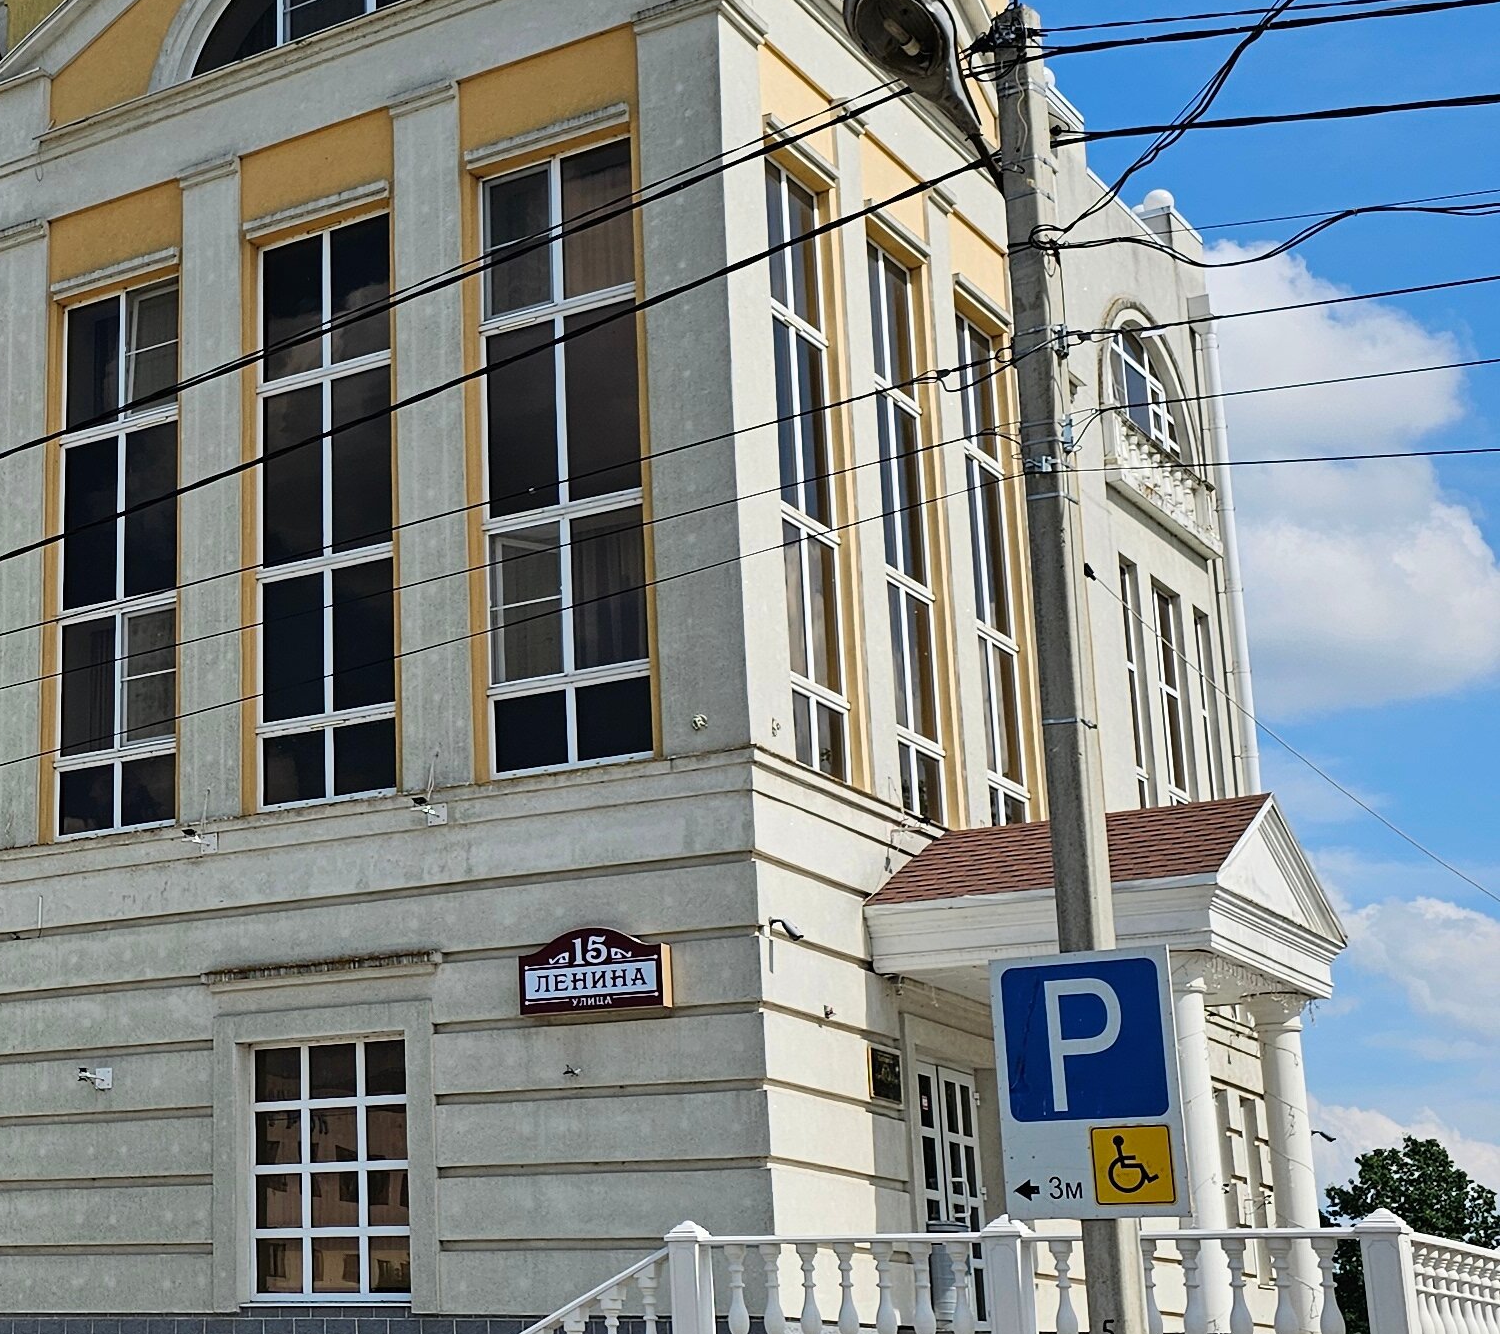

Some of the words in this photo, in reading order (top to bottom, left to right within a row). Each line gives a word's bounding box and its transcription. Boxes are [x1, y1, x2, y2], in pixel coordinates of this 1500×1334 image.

[572, 935, 608, 965] 15
[534, 967, 648, 993] ЛЕНИНА
[571, 995, 613, 1007] УЛИЦА
[1043, 977, 1122, 1112] P
